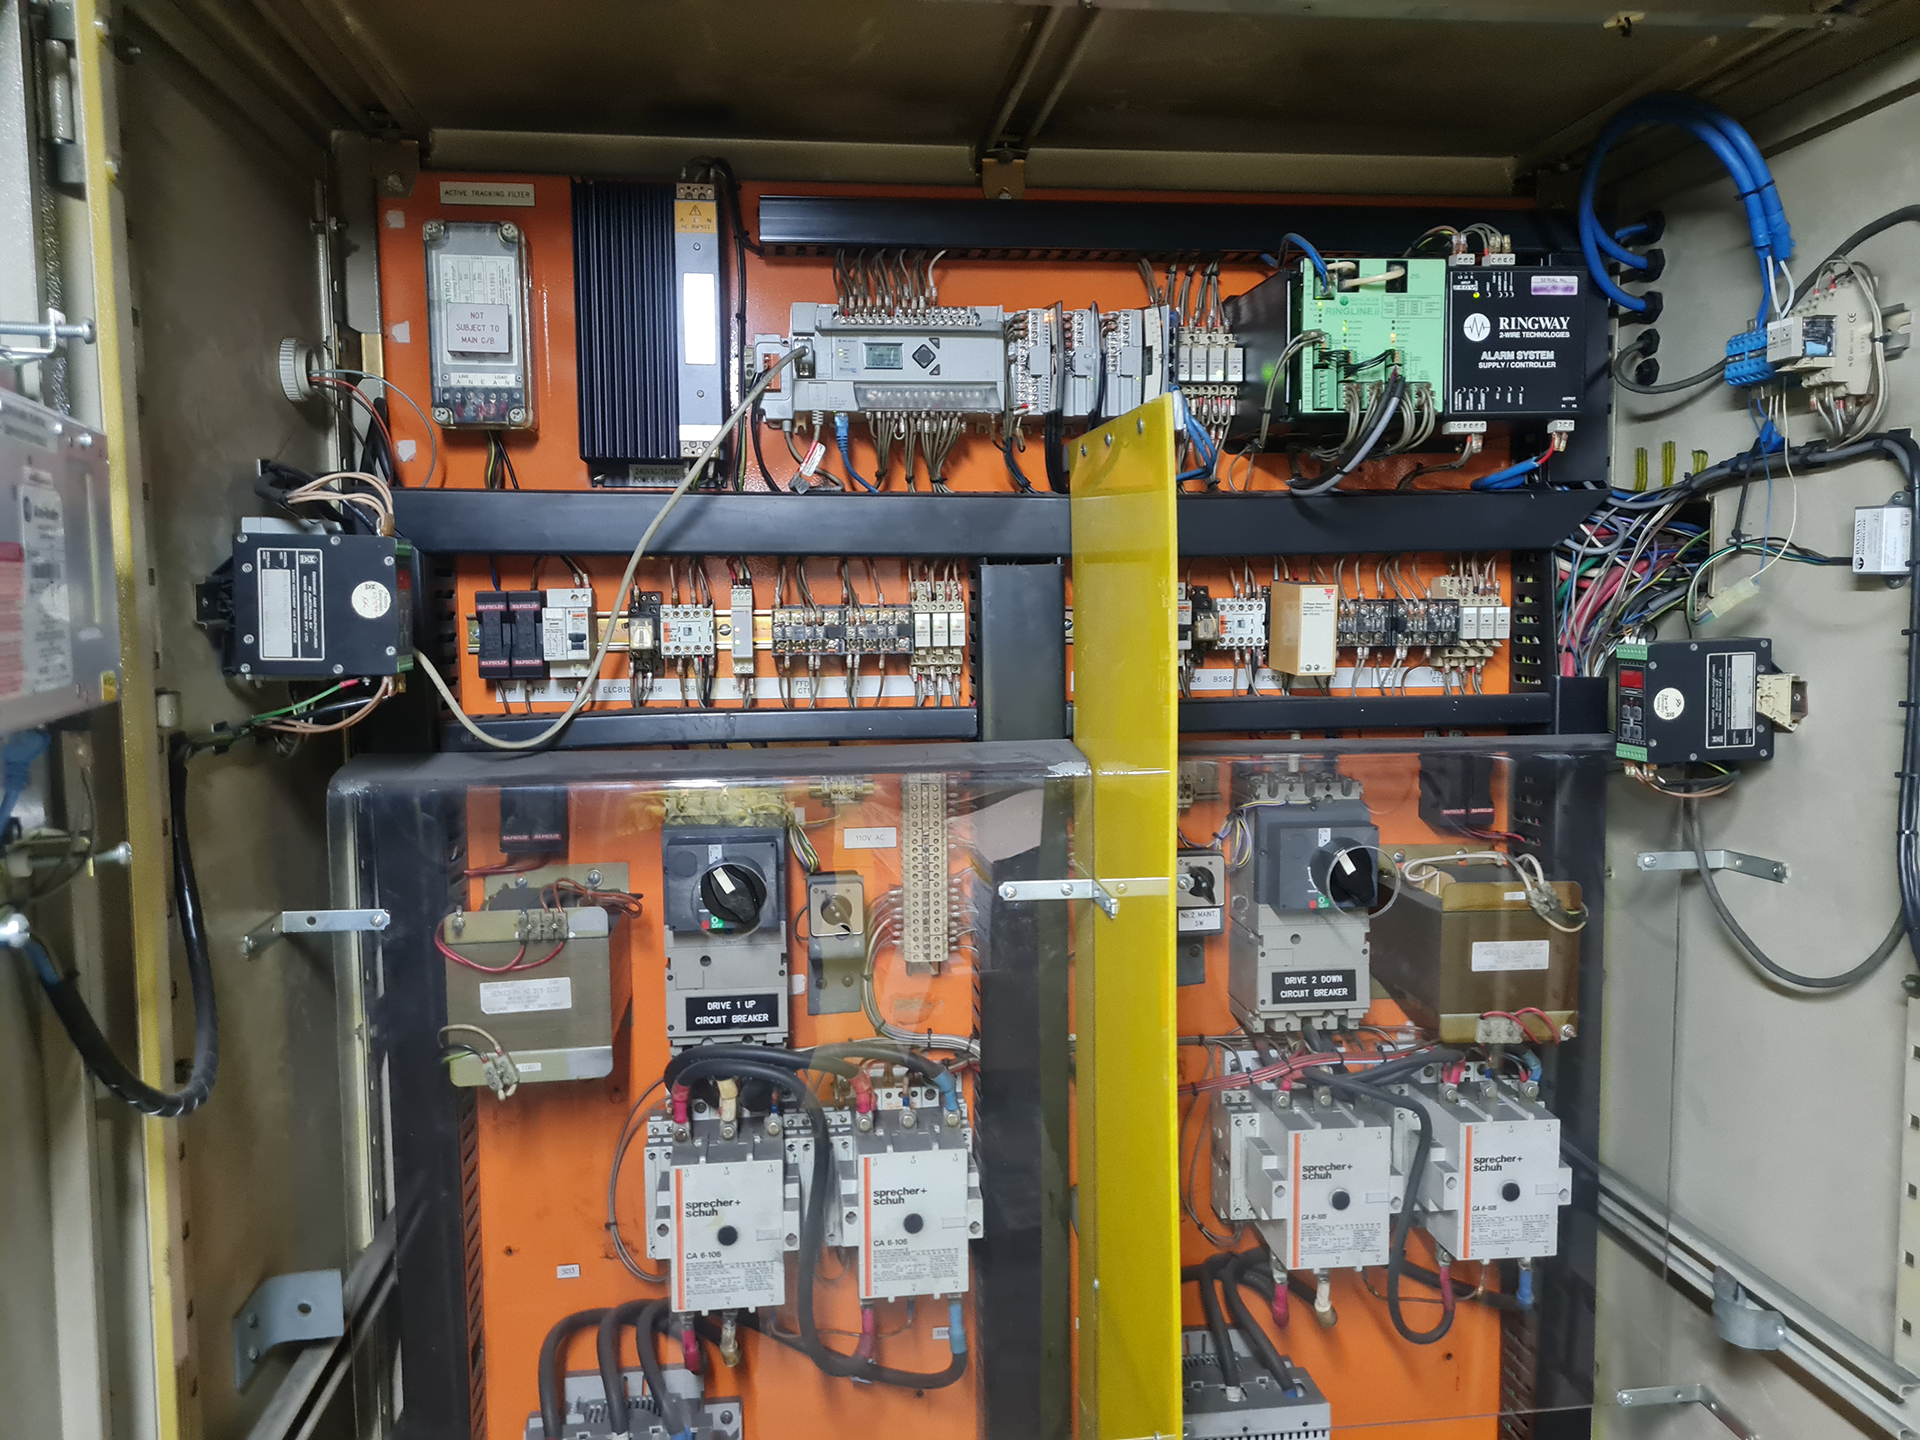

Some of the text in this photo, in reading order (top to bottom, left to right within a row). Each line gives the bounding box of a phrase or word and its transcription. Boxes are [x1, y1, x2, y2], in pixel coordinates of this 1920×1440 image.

[444, 189, 530, 198] ACTIVE TRACKING FILTER
[1326, 307, 1372, 316] RINGLINE
[456, 323, 486, 332] SUBJECT
[1498, 316, 1570, 330] RINGWAY
[1480, 351, 1554, 360] ALARM SYSTEM
[1284, 975, 1343, 985] DRIVE 2 DOWN
[1280, 988, 1348, 998] CIRCUIT BREAKER
[707, 1001, 732, 1010] DRIVE
[744, 1000, 756, 1008] UP
[695, 1014, 769, 1025] CIRCUIT BREAKER
[1474, 1155, 1523, 1164] sprecher+
[1302, 1163, 1353, 1173] sprecher+
[1473, 1163, 1502, 1172] schuh
[1302, 1172, 1332, 1180] schuh
[874, 1187, 927, 1199] sprecher+
[686, 1199, 741, 1210] sprecher+
[874, 1197, 905, 1205] schuh
[686, 1208, 718, 1218] schuh
